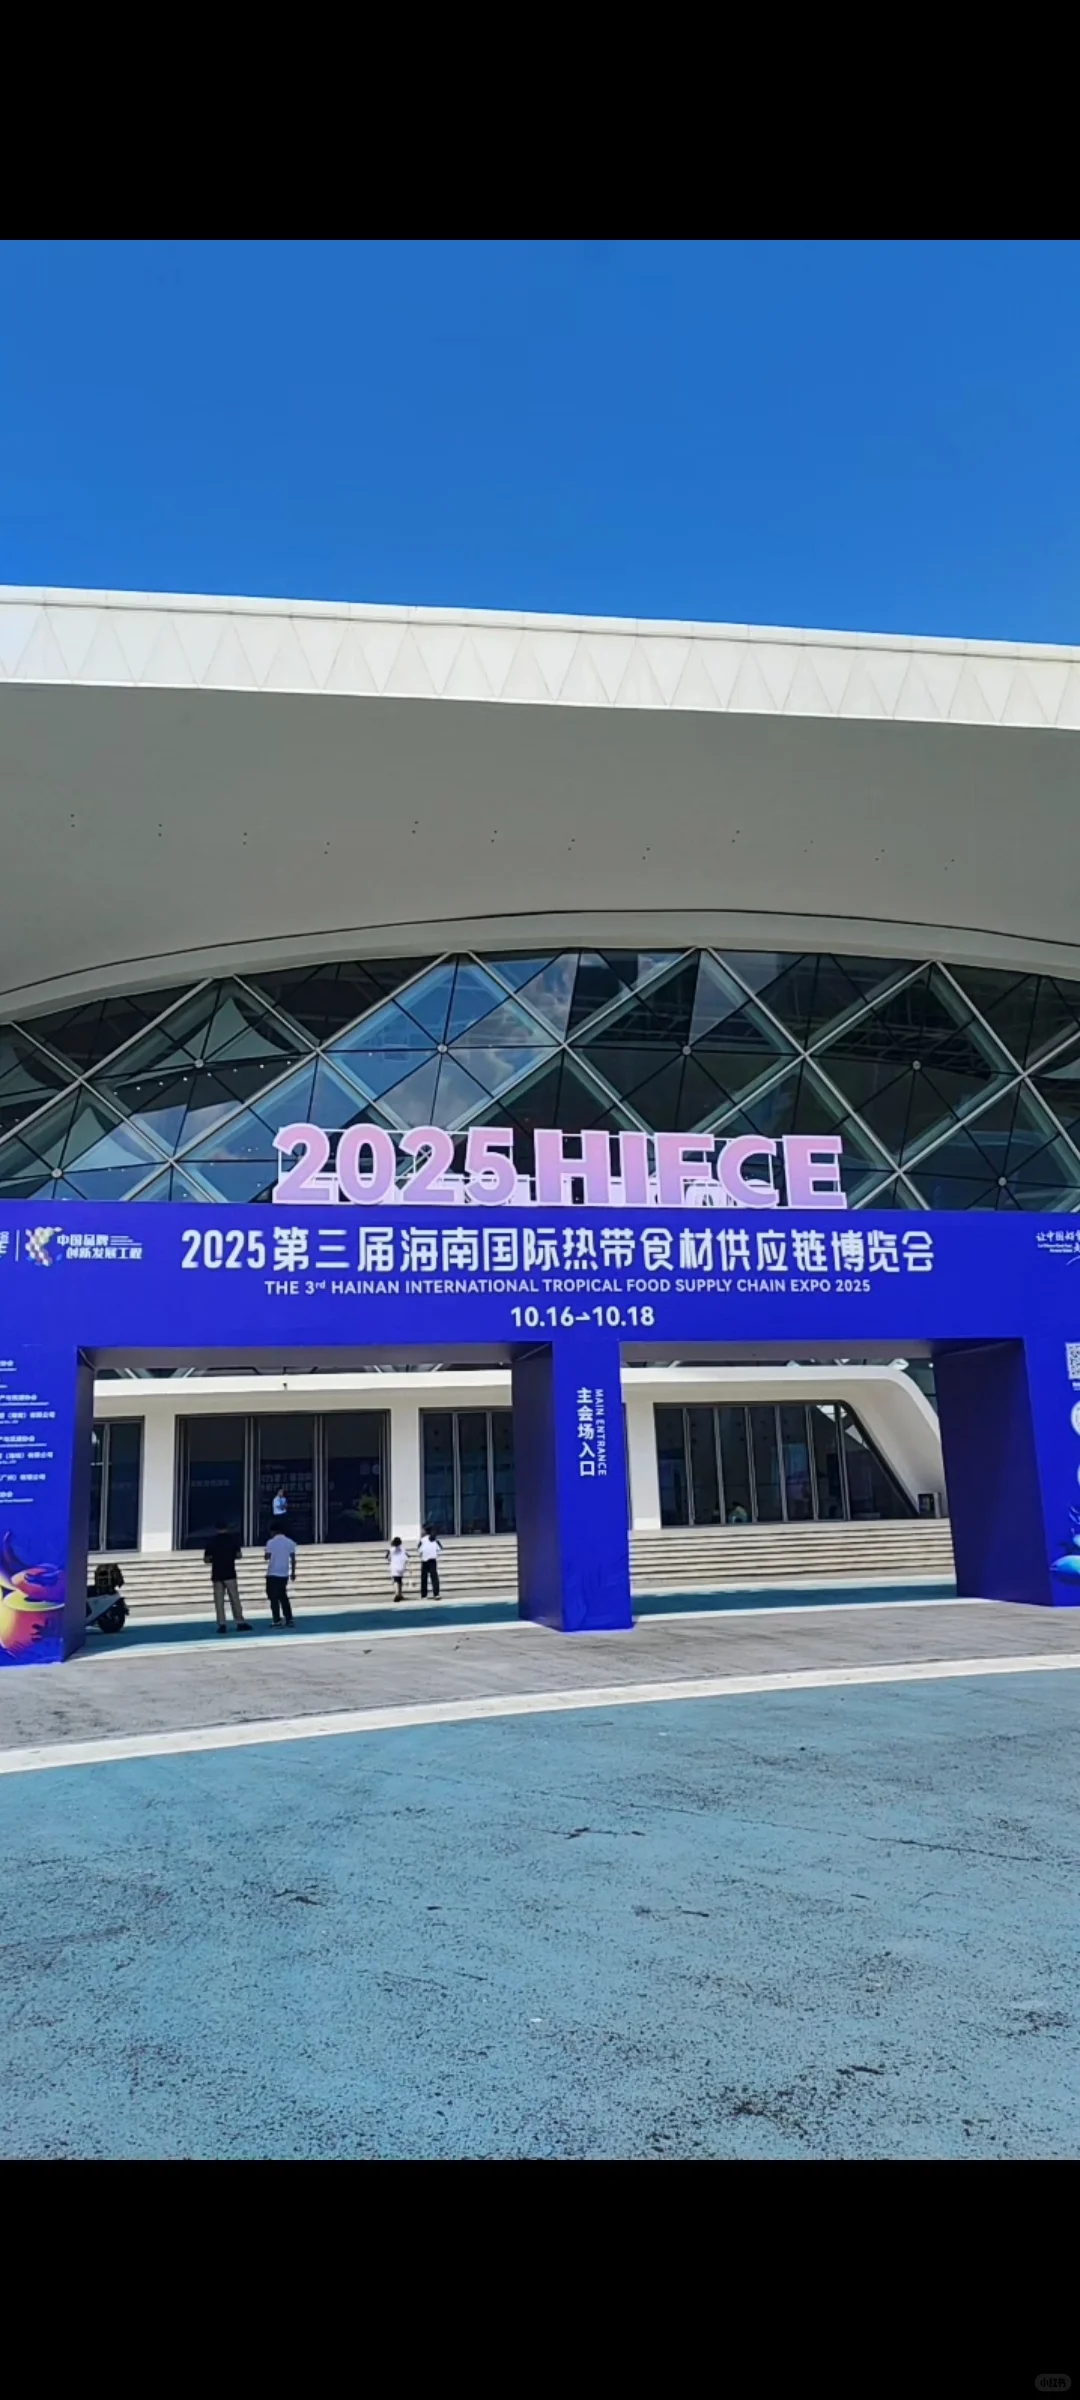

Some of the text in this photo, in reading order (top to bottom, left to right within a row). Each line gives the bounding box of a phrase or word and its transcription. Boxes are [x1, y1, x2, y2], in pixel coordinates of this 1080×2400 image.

[272, 1123, 847, 1208] 2025 HIFCE
[57, 1234, 109, 1246] 中国品牌
[66, 1247, 142, 1259] 创新发展工程
[181, 1226, 934, 1272] 2025第三届海南国际热带食材供应链博览会
[264, 1279, 870, 1295] THE 3rd HAINAN INTERNATIONAL TROPICAL FOOD SUPPLY CHAIN EXPO 2025
[511, 1306, 655, 1327] 10.16 10.18
[577, 1387, 595, 1476] 主会场入口
[595, 1389, 607, 1476] MAIN ENTRANCE
